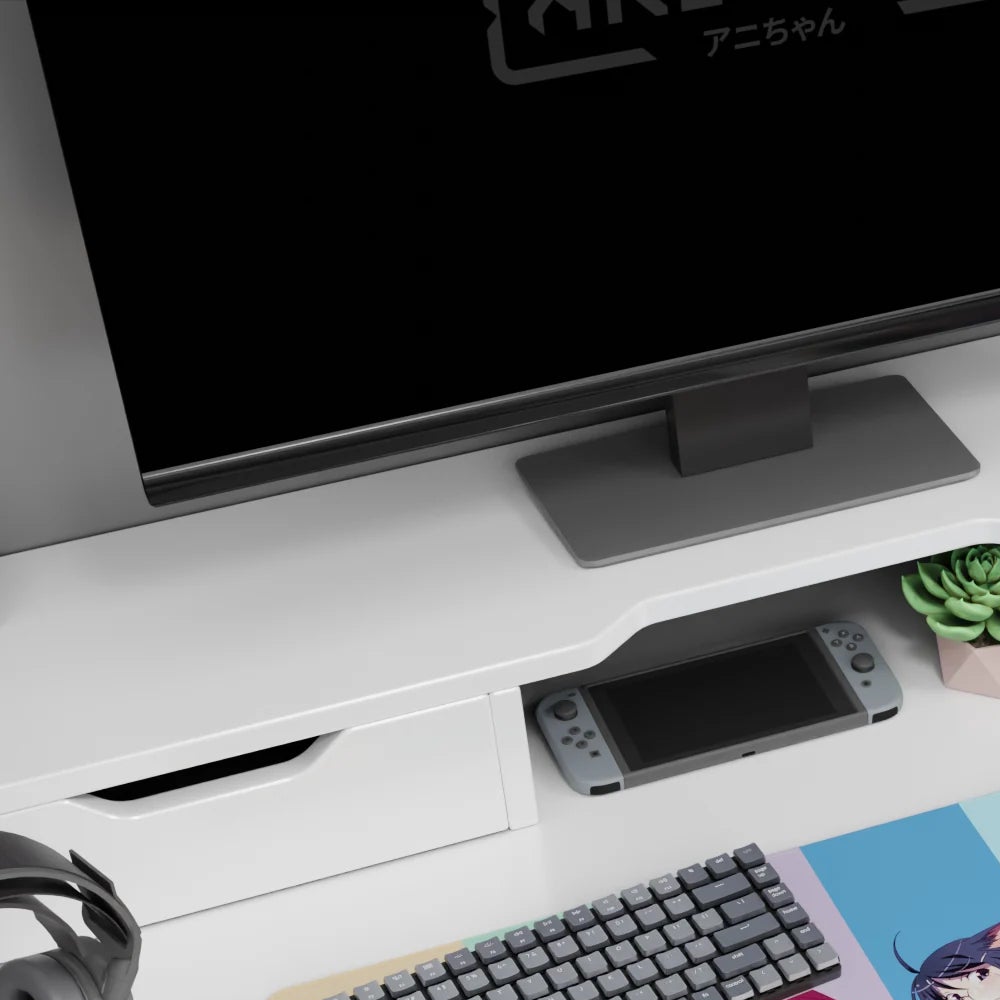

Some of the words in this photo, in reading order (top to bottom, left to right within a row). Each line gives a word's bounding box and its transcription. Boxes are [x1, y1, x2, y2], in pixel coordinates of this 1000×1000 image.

[703, 7, 846, 57] アニちゃん
[725, 978, 744, 989] control
